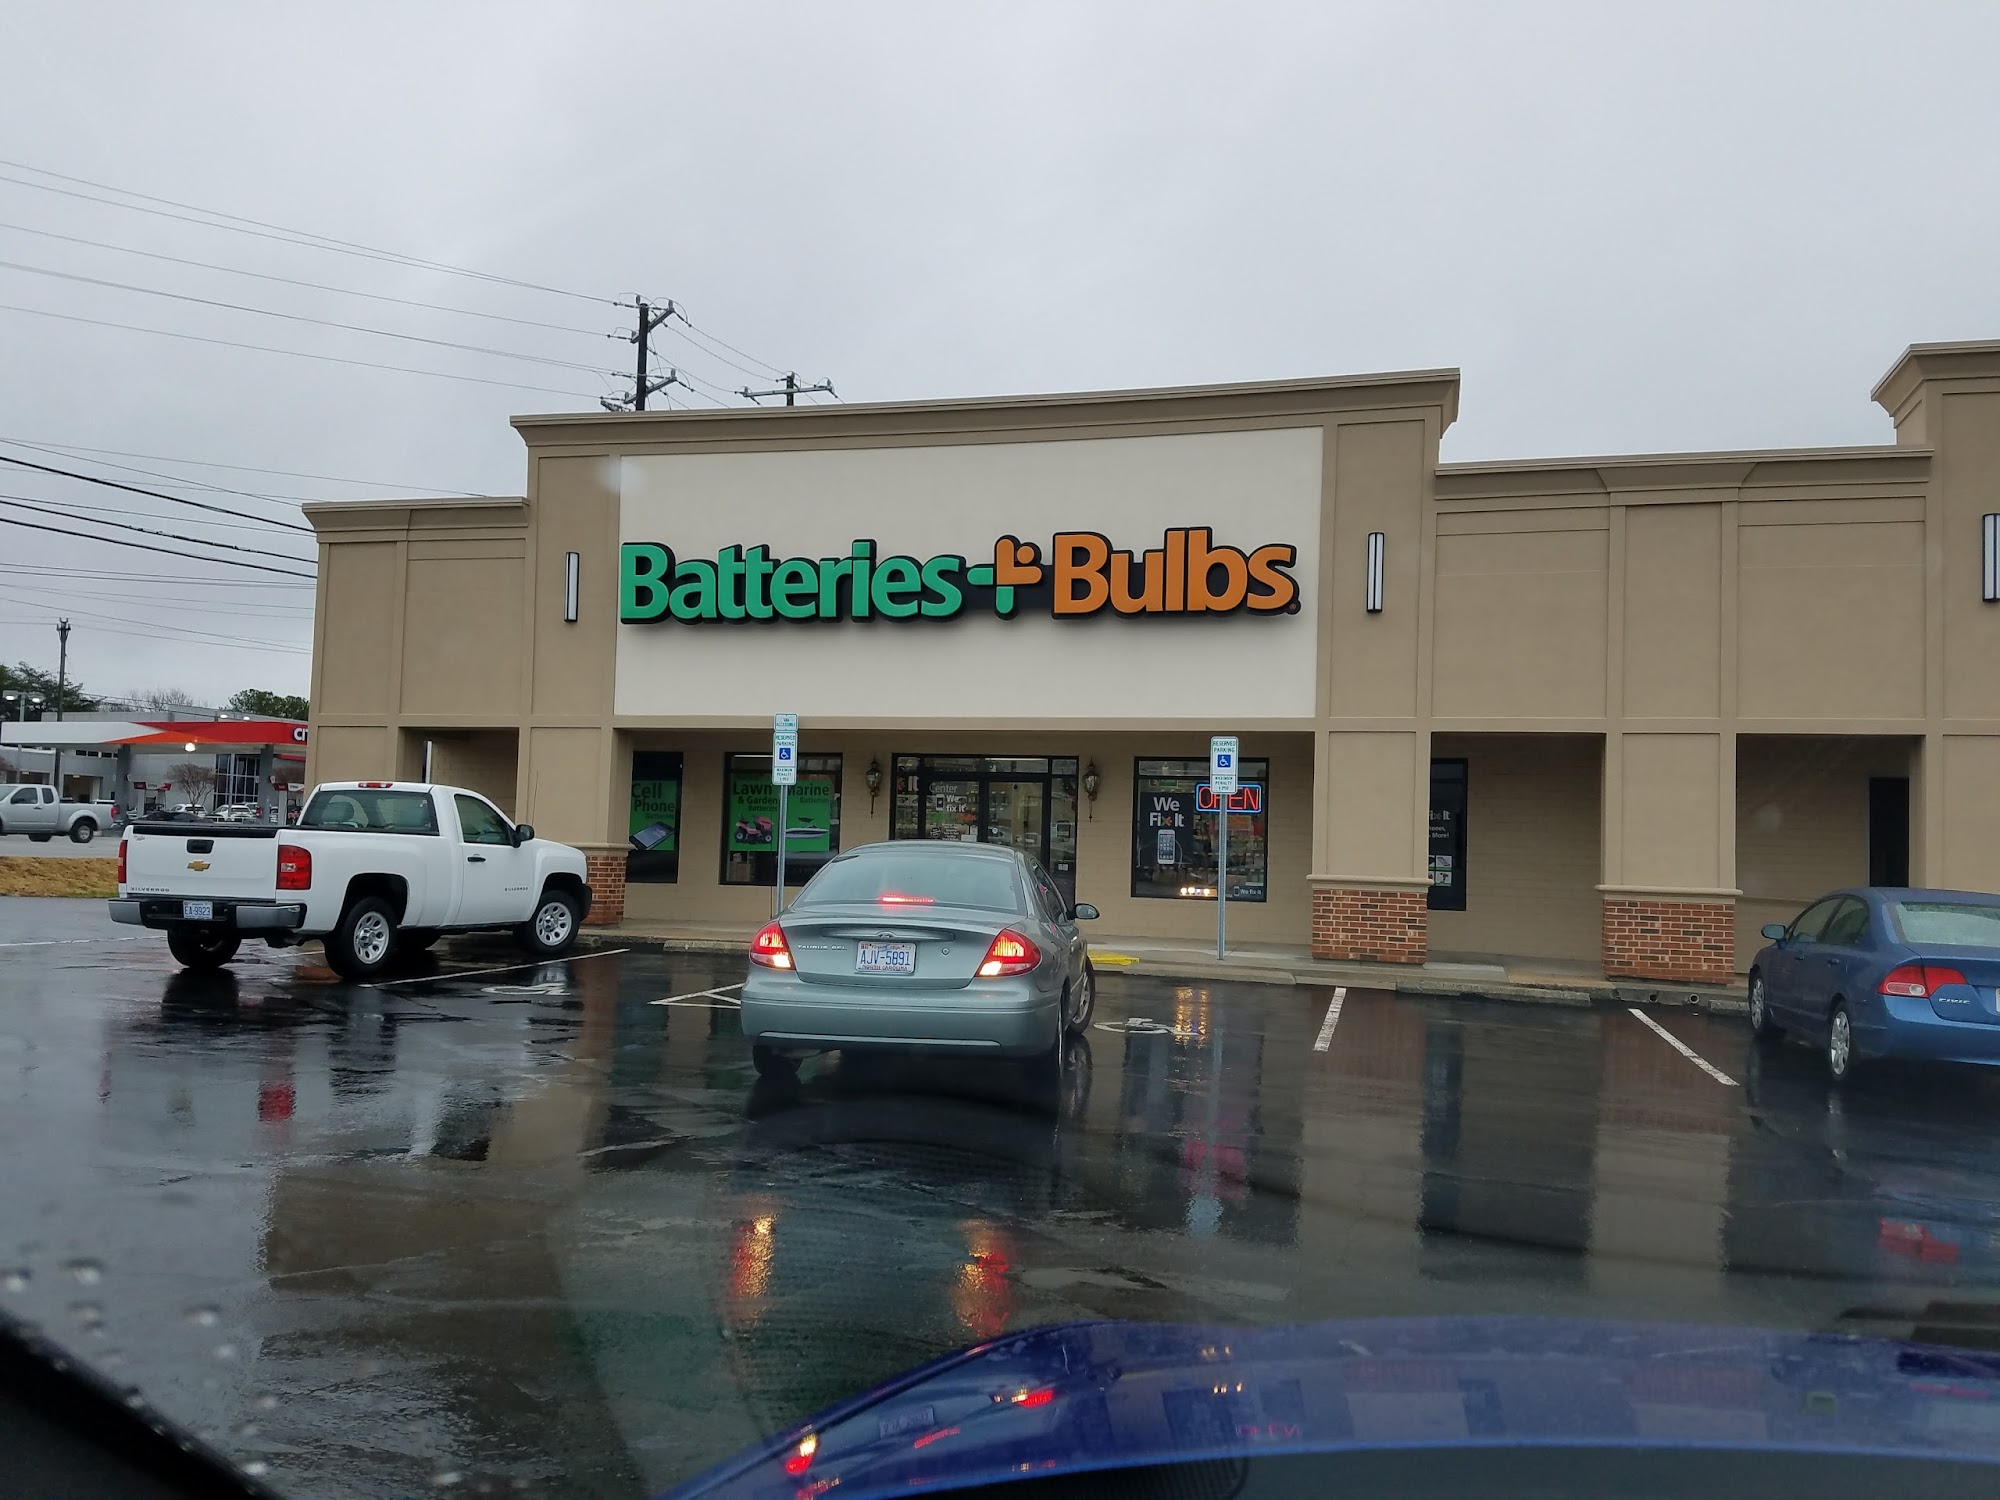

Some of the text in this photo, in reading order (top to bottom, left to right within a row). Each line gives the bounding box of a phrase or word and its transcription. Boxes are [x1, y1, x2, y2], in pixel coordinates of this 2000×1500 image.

[620, 539, 965, 623] Batteries
[1053, 528, 1297, 617] Bulbs
[632, 782, 662, 799] Cell
[733, 782, 772, 795] Lawn
[929, 782, 958, 794] Center
[634, 799, 675, 812] Phone
[737, 796, 778, 804] & Garden
[946, 795, 959, 803] We
[1153, 797, 1180, 811] We
[946, 804, 957, 812] fix
[1149, 812, 1185, 827] Fix It
[1429, 810, 1450, 820] ix It
[860, 949, 911, 966] AJV-5891
